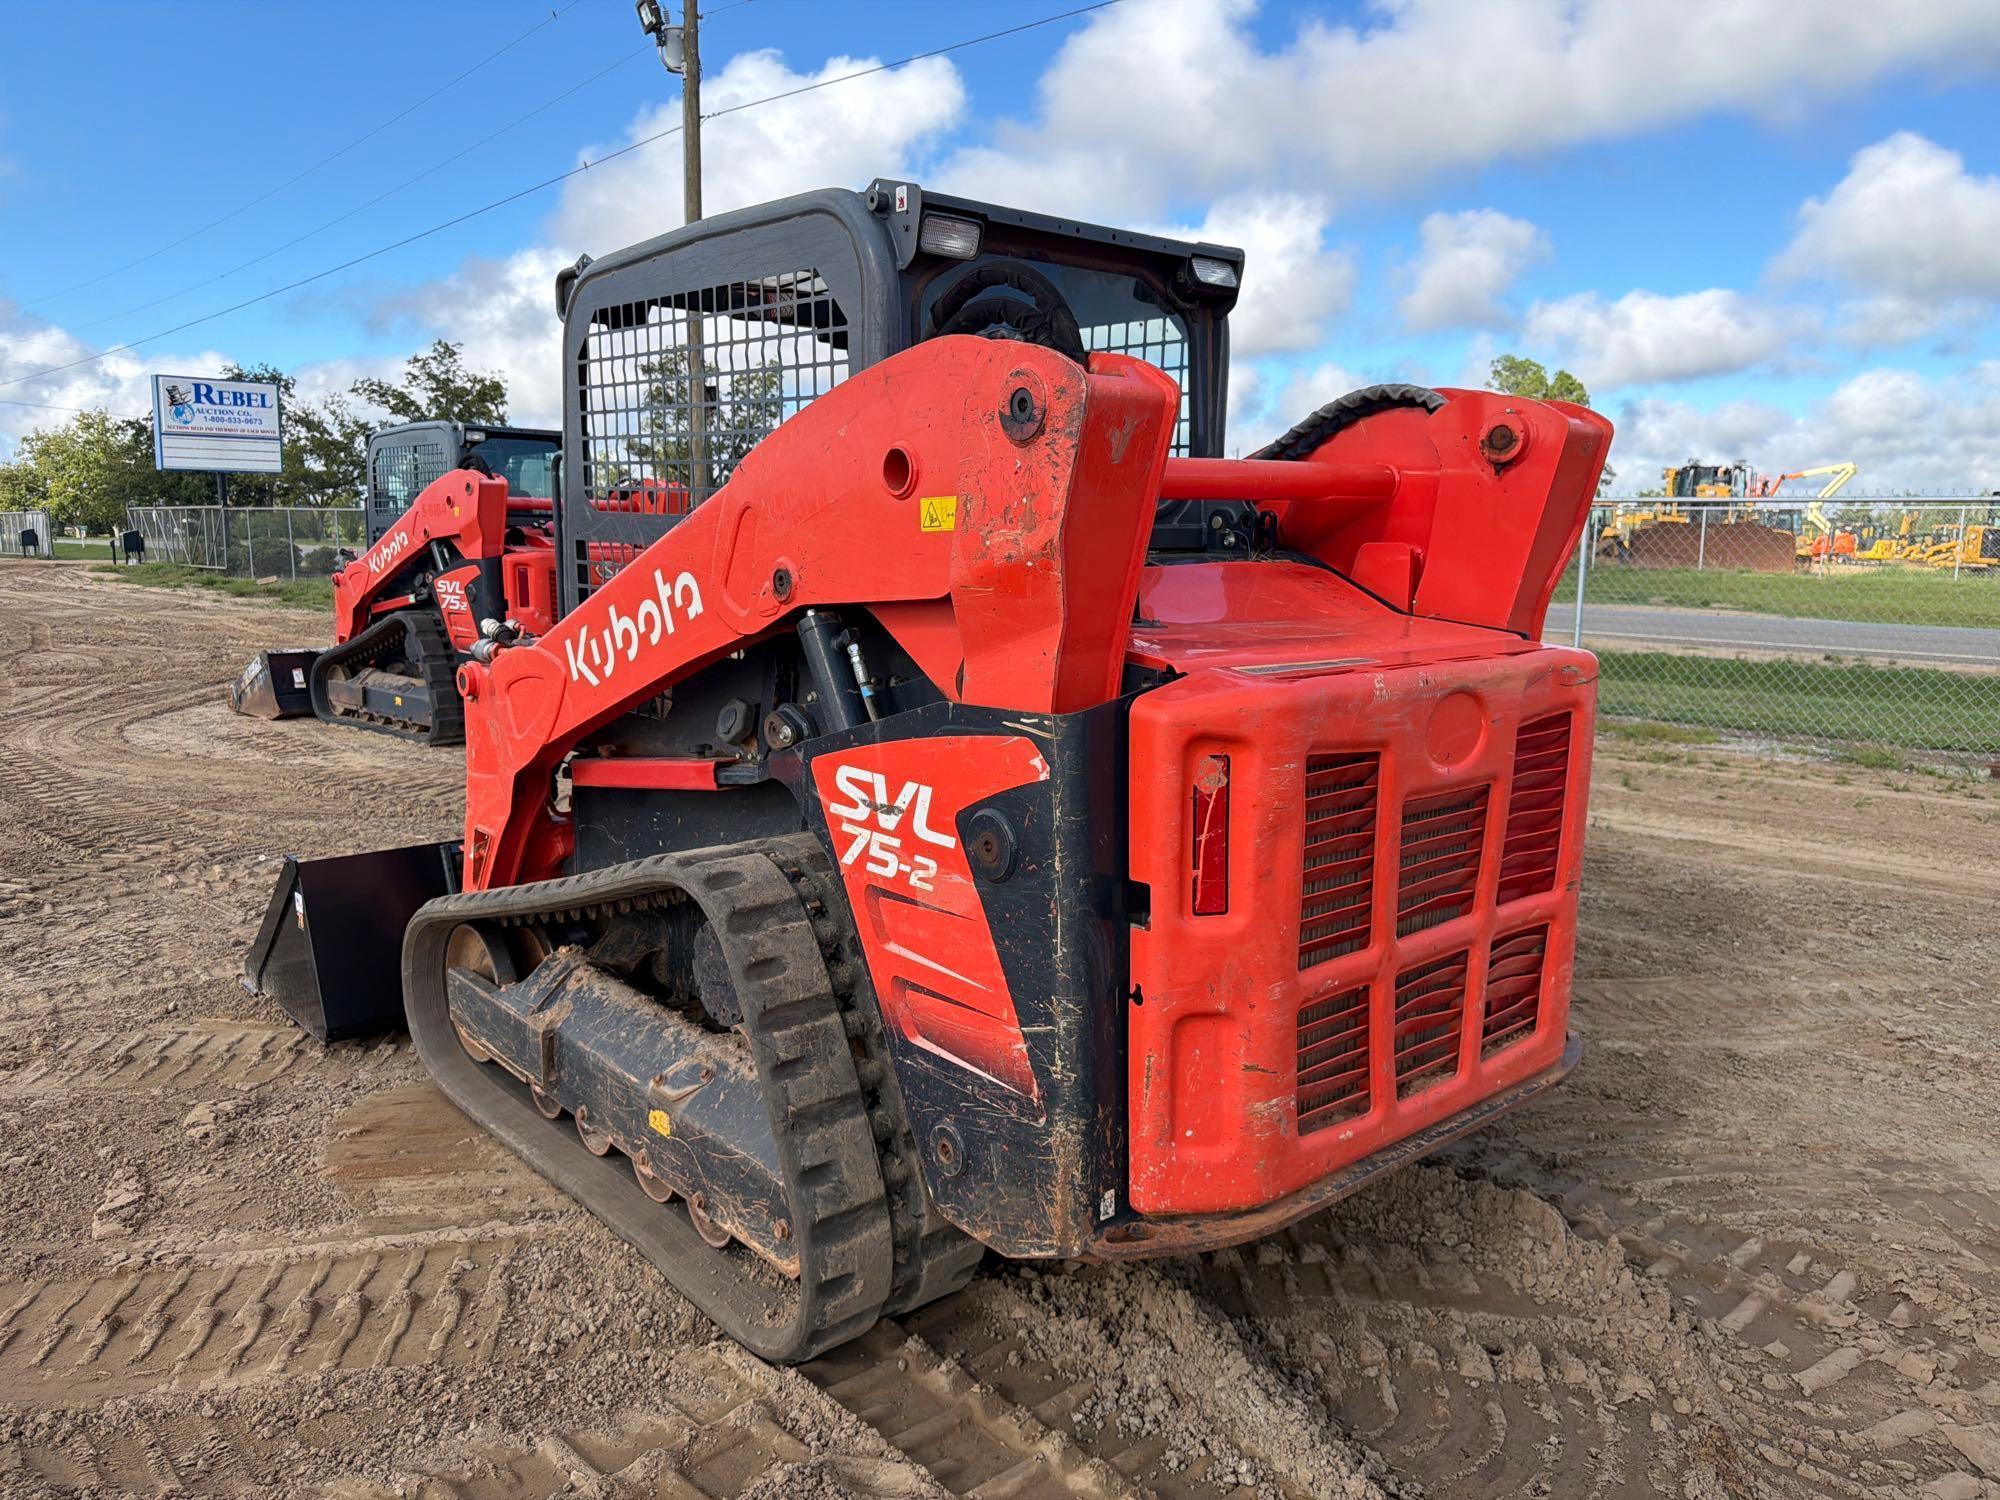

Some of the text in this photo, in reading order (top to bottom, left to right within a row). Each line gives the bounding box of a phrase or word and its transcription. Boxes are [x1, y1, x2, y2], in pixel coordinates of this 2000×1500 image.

[192, 383, 273, 408] REBEL
[195, 408, 252, 417] AUCTION CO.
[368, 531, 408, 573] Kubota
[437, 580, 465, 595] SVL
[441, 595, 468, 611] 75-2
[565, 568, 704, 687] Kubota
[829, 764, 957, 849] SVL
[841, 822, 938, 892] 75-2
